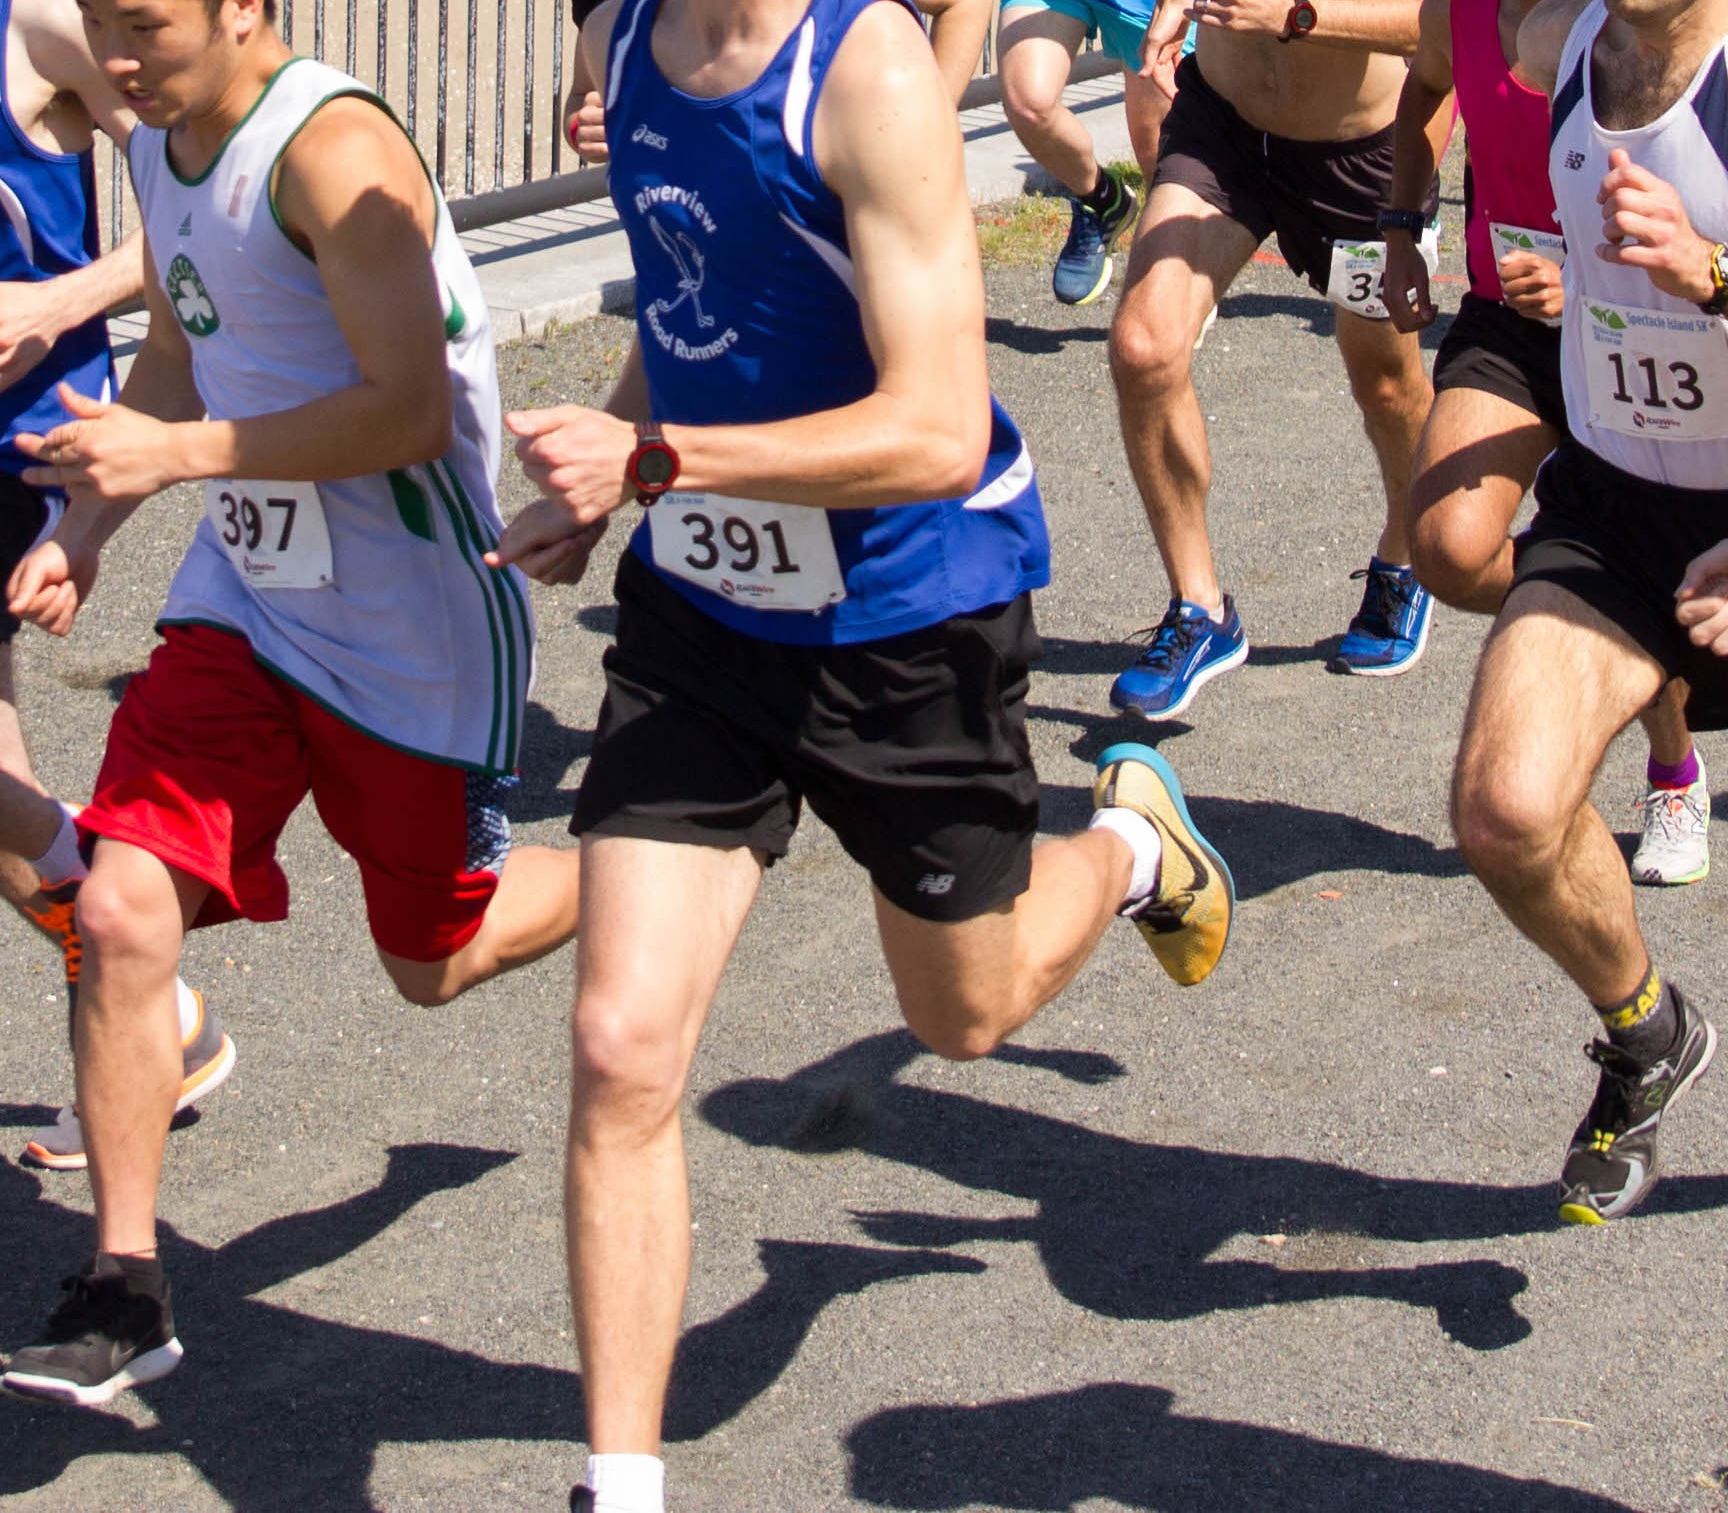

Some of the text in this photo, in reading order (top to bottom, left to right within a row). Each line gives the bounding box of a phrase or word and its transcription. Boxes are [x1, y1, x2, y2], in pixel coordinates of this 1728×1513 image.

[643, 132, 669, 151] asics
[634, 184, 718, 234] Riverview
[645, 302, 740, 362] Road Runners
[1625, 310, 1709, 333] Spectacle Island 5K
[1607, 352, 1705, 411] 113
[219, 491, 298, 552] 397
[681, 511, 801, 574] 391
